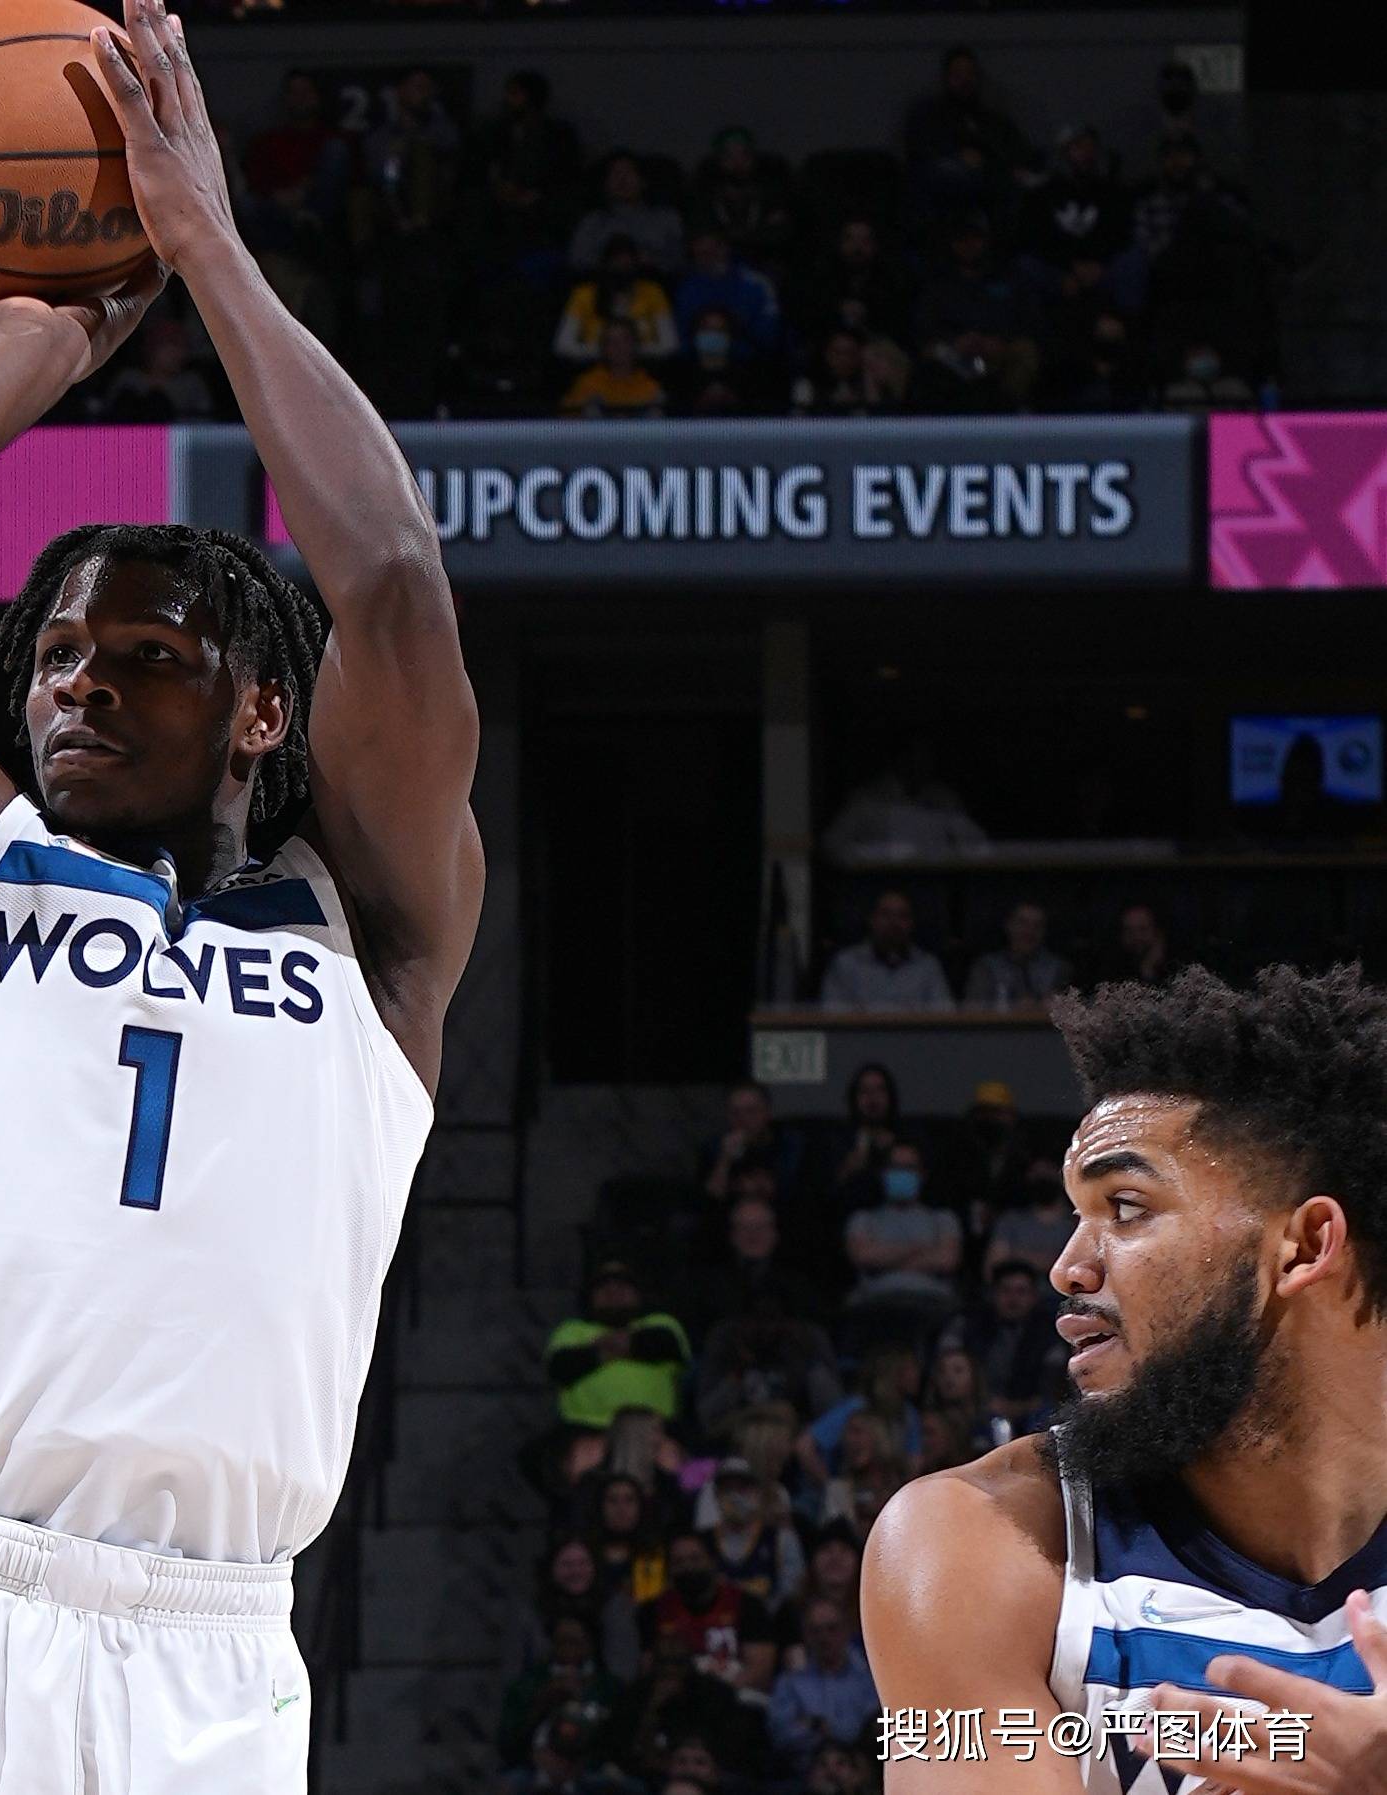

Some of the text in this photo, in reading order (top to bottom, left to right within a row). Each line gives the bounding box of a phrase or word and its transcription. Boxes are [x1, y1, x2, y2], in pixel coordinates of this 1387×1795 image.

[417, 462, 1133, 540] UPCOMING EVENTS
[118, 1024, 183, 1211] 1
